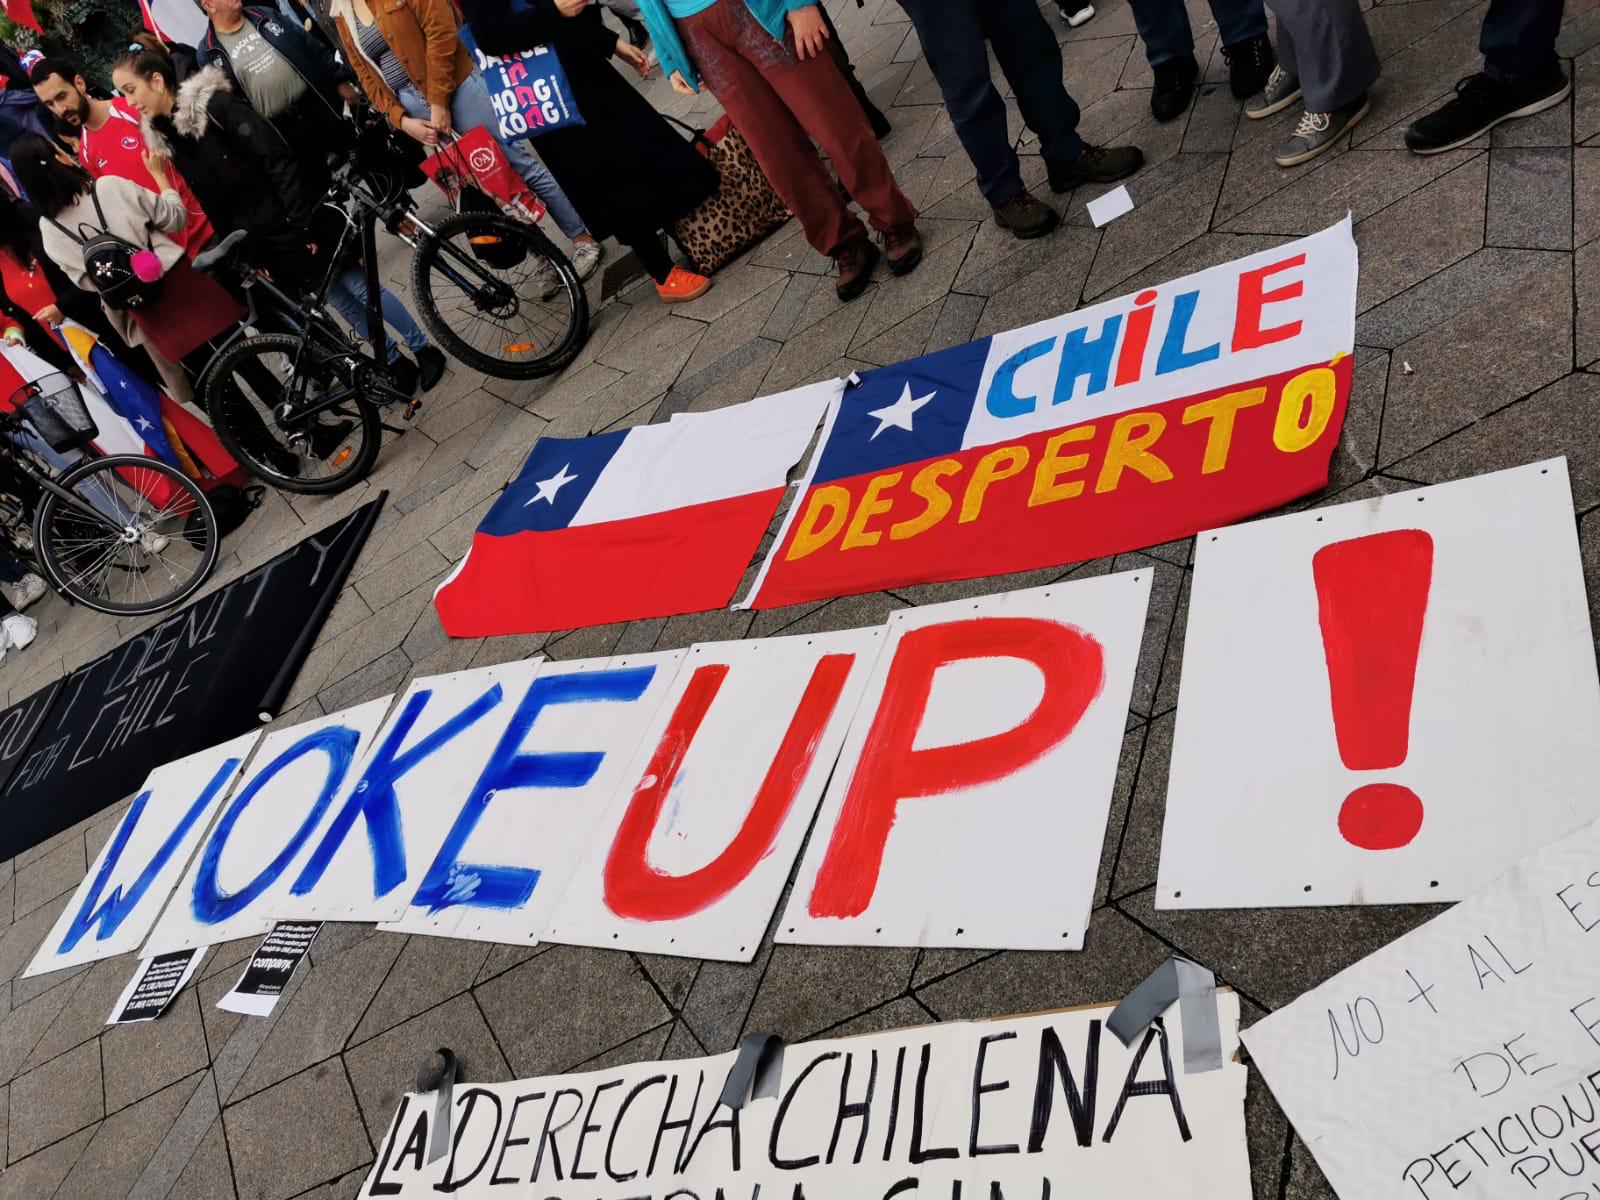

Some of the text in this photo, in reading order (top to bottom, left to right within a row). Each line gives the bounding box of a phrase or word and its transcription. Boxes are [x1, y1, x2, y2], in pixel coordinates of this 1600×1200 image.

[490, 79, 552, 118] HONG
[498, 101, 560, 139] KONG
[6, 652, 210, 796] FOR CHILE
[56, 528, 1434, 955] WOKE UP !
[1328, 997, 1384, 1081] NO
[1467, 934, 1533, 991] AL
[1453, 1033, 1558, 1098] DE
[368, 1016, 1193, 1196] LA DERECHA CHILENA
